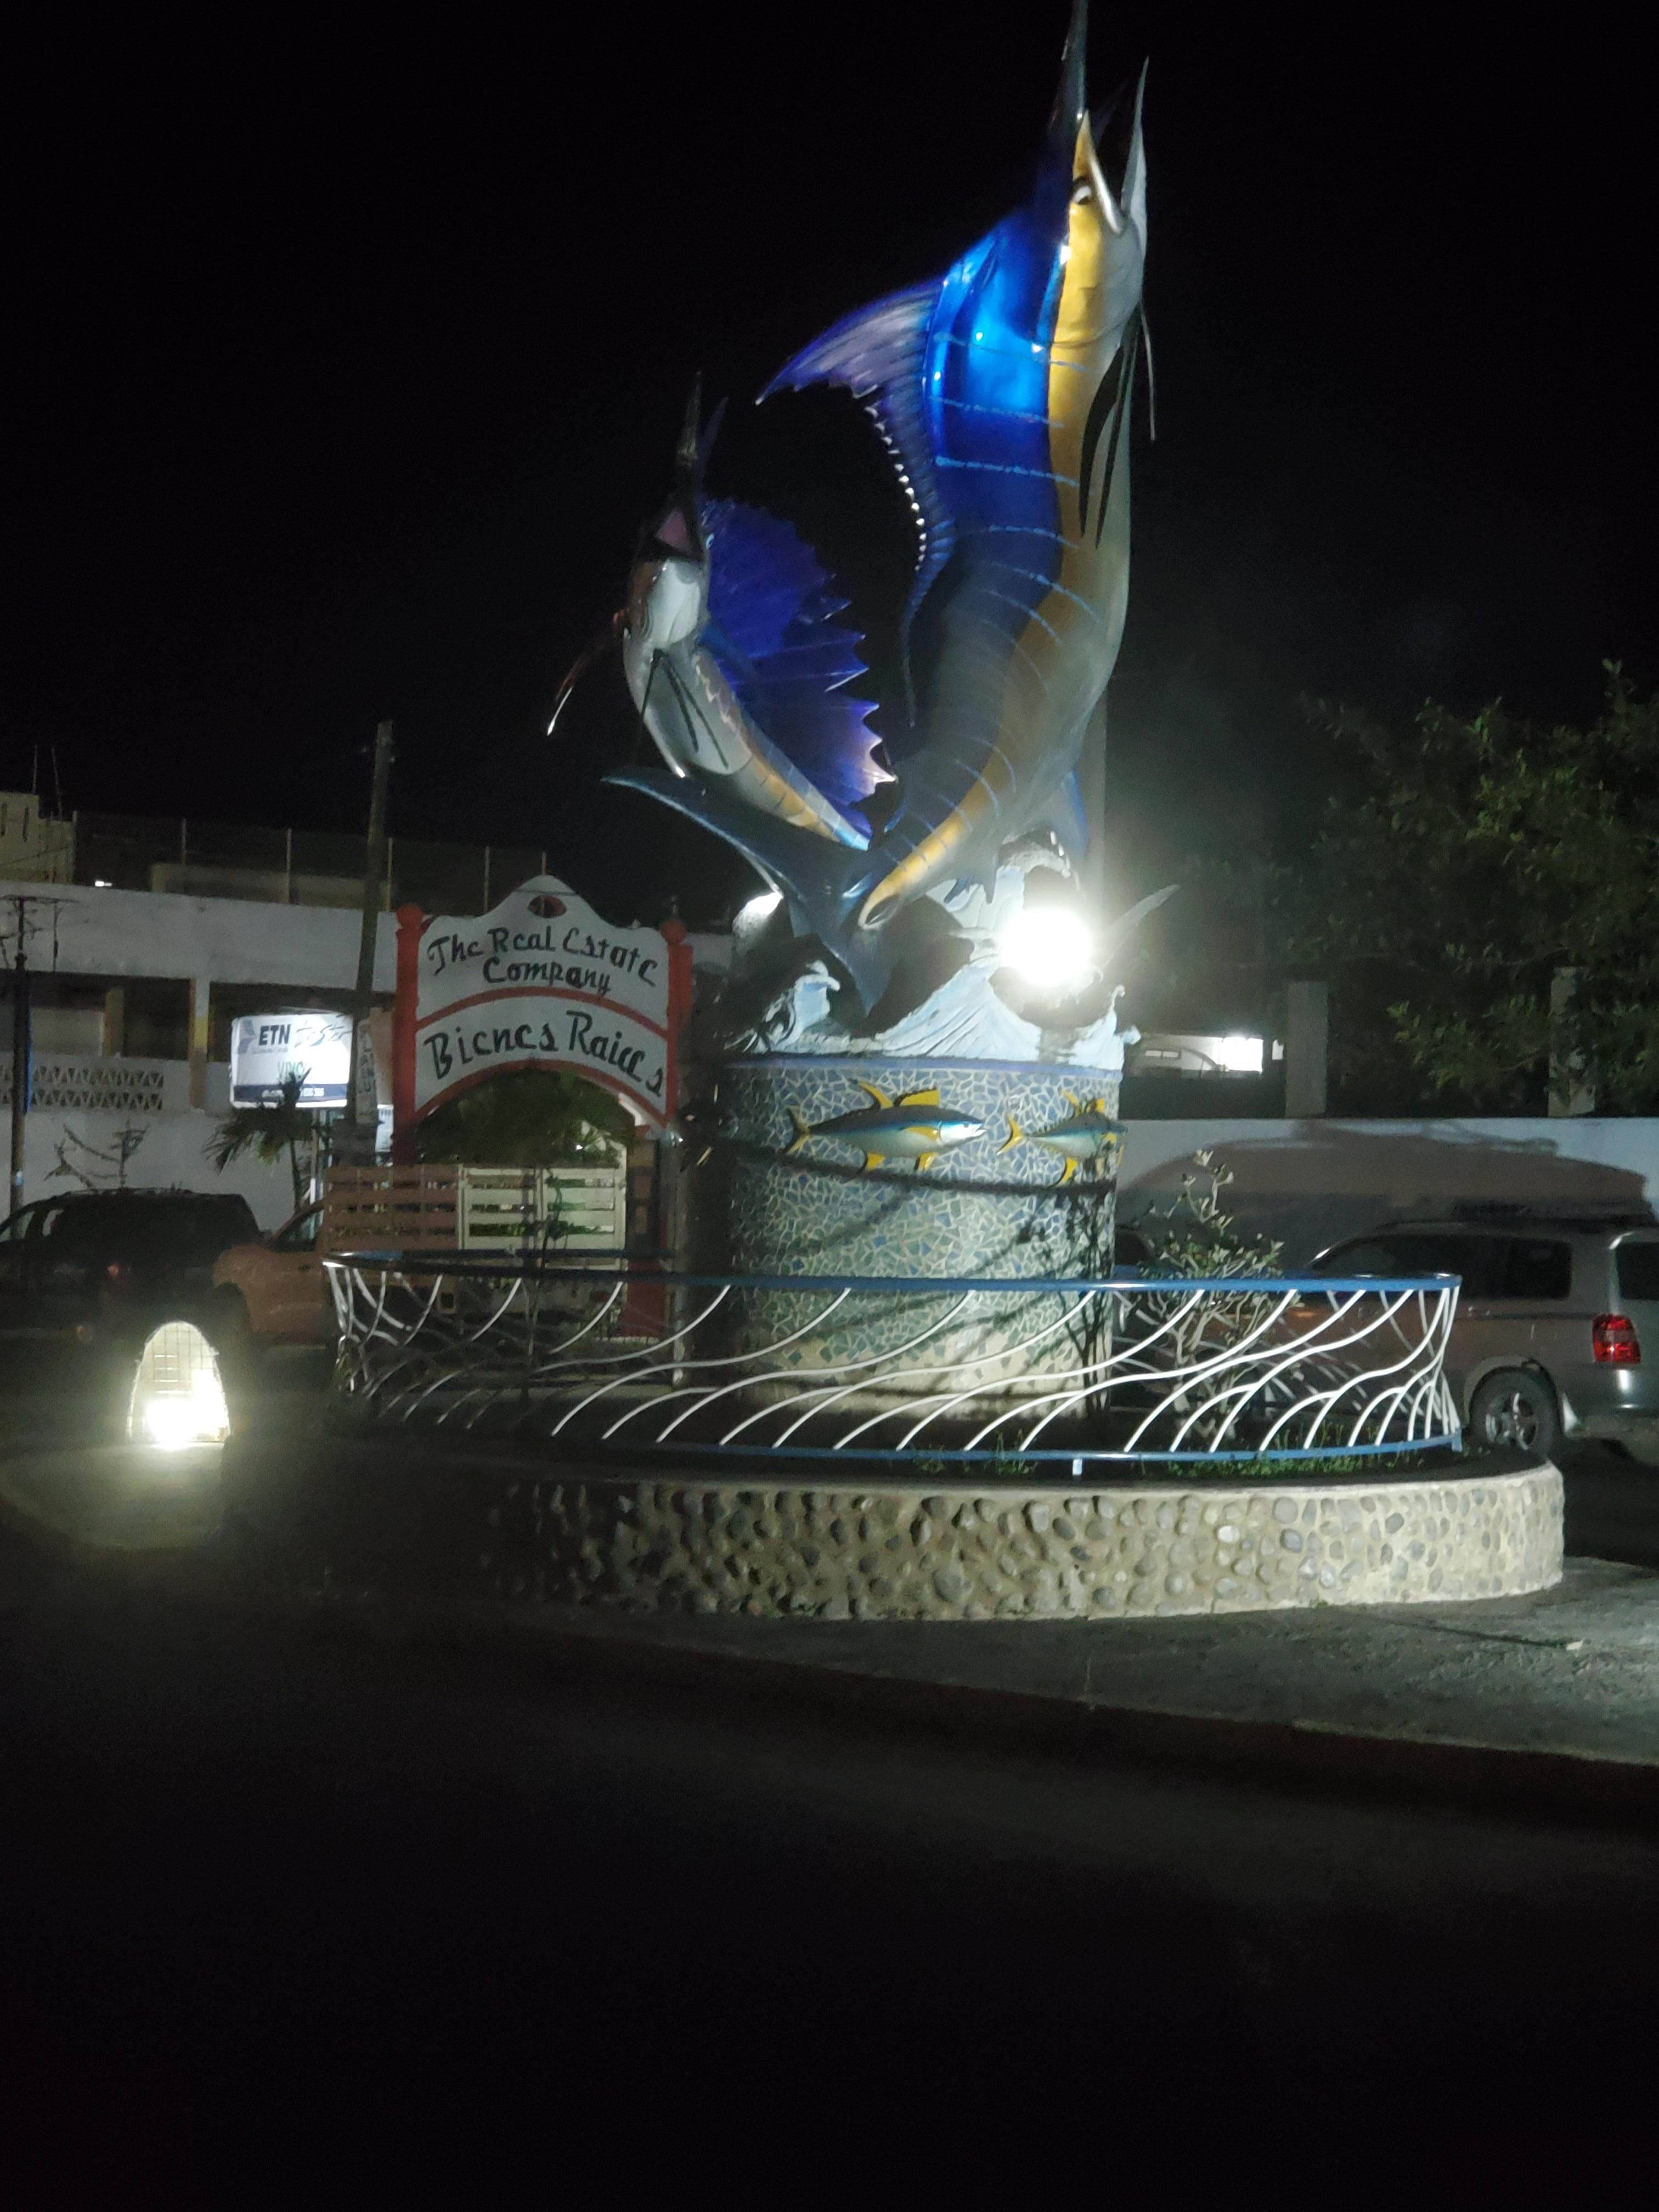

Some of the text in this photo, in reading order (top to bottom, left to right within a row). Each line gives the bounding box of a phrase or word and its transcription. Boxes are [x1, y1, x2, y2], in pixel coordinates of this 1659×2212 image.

[427, 926, 658, 987] The Real Estate
[483, 957, 611, 997] Company
[258, 1024, 291, 1046] ETN
[424, 1023, 559, 1080] Bienes
[566, 1010, 663, 1097] Raices
